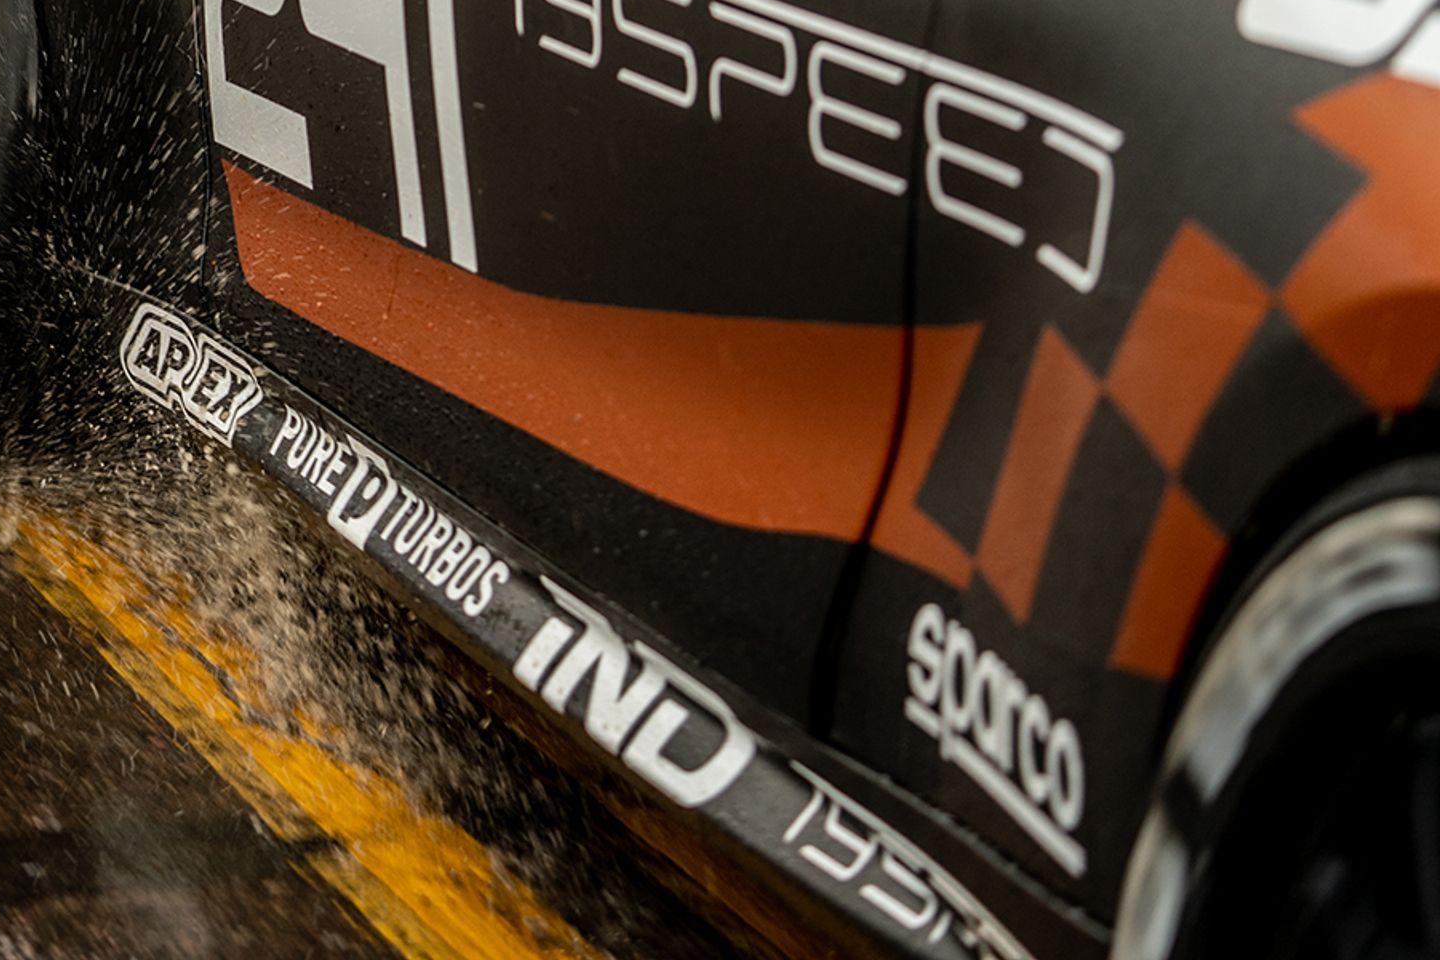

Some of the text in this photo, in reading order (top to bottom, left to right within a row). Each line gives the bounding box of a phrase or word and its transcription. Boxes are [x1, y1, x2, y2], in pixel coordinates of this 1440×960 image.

[127, 314, 257, 435] APEX
[269, 404, 353, 496] PURE
[380, 485, 510, 617] TURBOS
[513, 574, 762, 808] IND
[905, 603, 1086, 878] sparco
